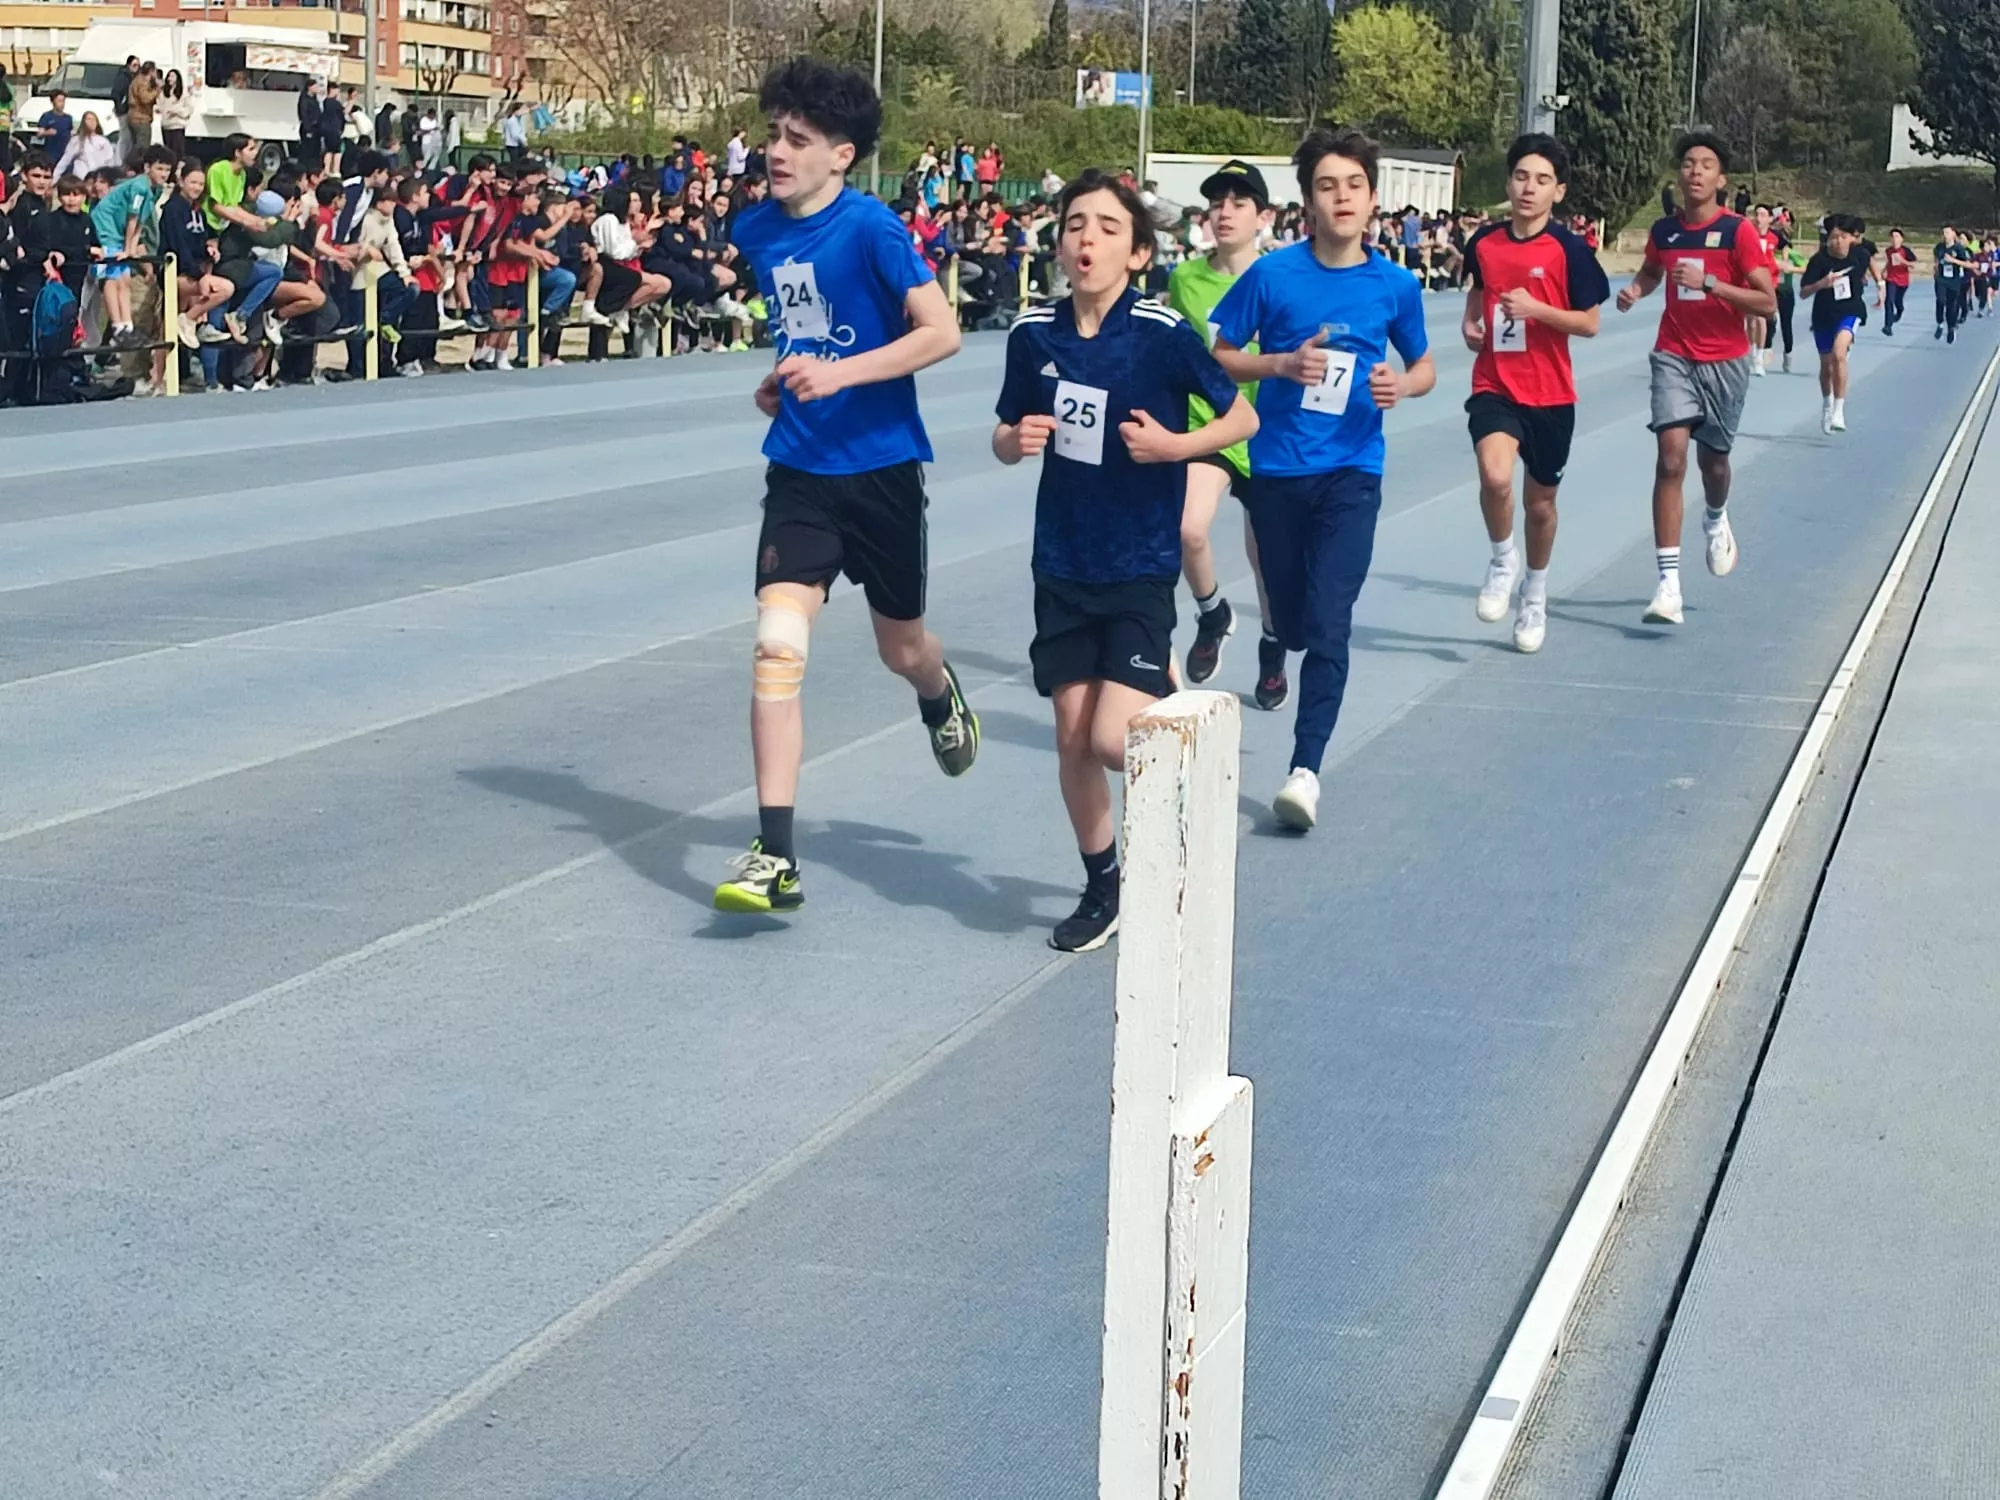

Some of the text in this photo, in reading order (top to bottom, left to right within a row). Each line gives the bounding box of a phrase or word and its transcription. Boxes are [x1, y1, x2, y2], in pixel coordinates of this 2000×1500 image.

[781, 281, 813, 308] 24
[1502, 318, 1516, 338] 2
[1061, 398, 1097, 429] 25
